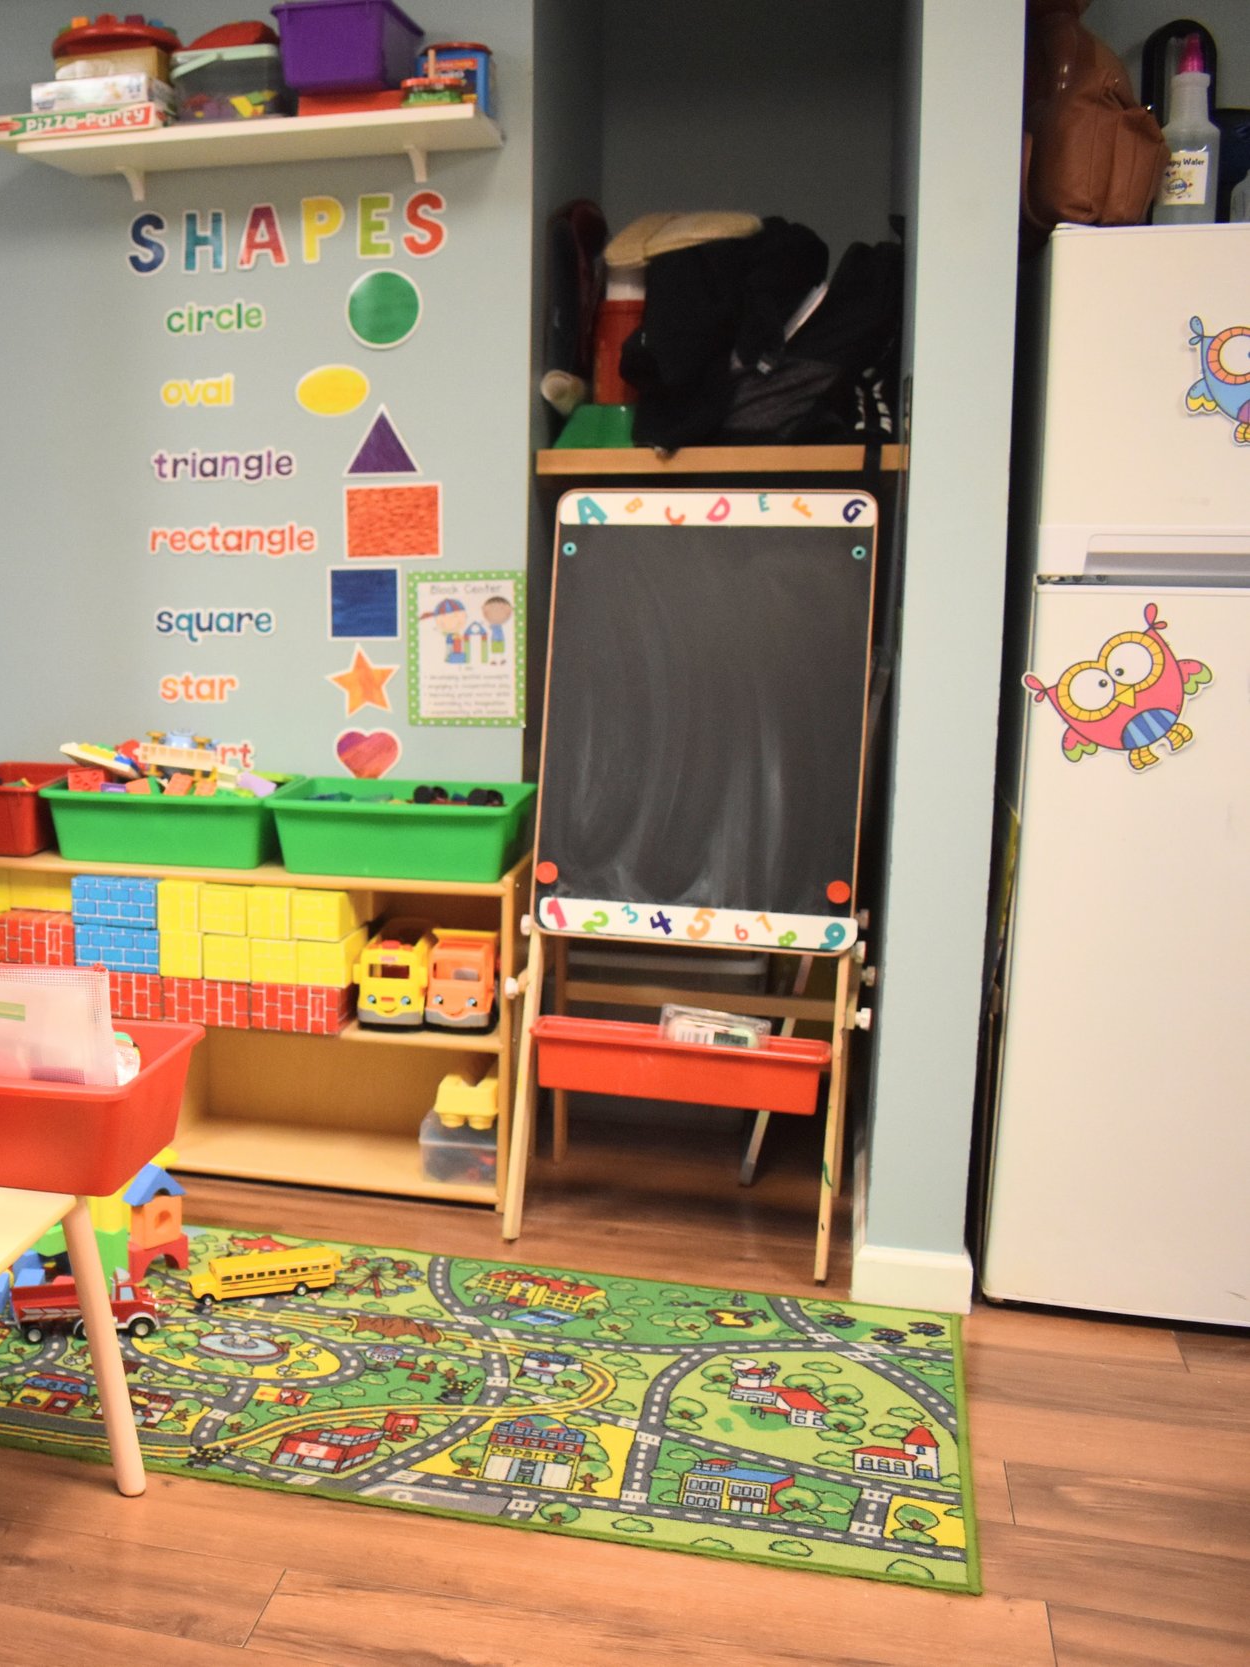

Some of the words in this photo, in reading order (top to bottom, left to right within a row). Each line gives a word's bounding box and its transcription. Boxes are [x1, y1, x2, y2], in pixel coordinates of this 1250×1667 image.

[128, 191, 447, 274] SHAPES
[165, 302, 264, 334] circle
[160, 373, 234, 406] oval
[153, 449, 293, 480] triangle
[576, 496, 608, 525] A
[624, 497, 644, 514] B
[706, 496, 731, 522] D
[757, 493, 770, 513] E
[791, 496, 813, 519] F
[842, 499, 867, 523] G
[150, 525, 316, 556] rectangle
[156, 611, 273, 643] square
[160, 674, 238, 701] star
[546, 898, 568, 929] 1
[581, 911, 610, 932] 2
[621, 903, 639, 925] 3
[650, 910, 672, 936] 4
[686, 907, 717, 940] 5
[734, 923, 749, 942] 6
[756, 913, 773, 933] 7
[777, 930, 798, 947] 8
[819, 922, 847, 950] 9
